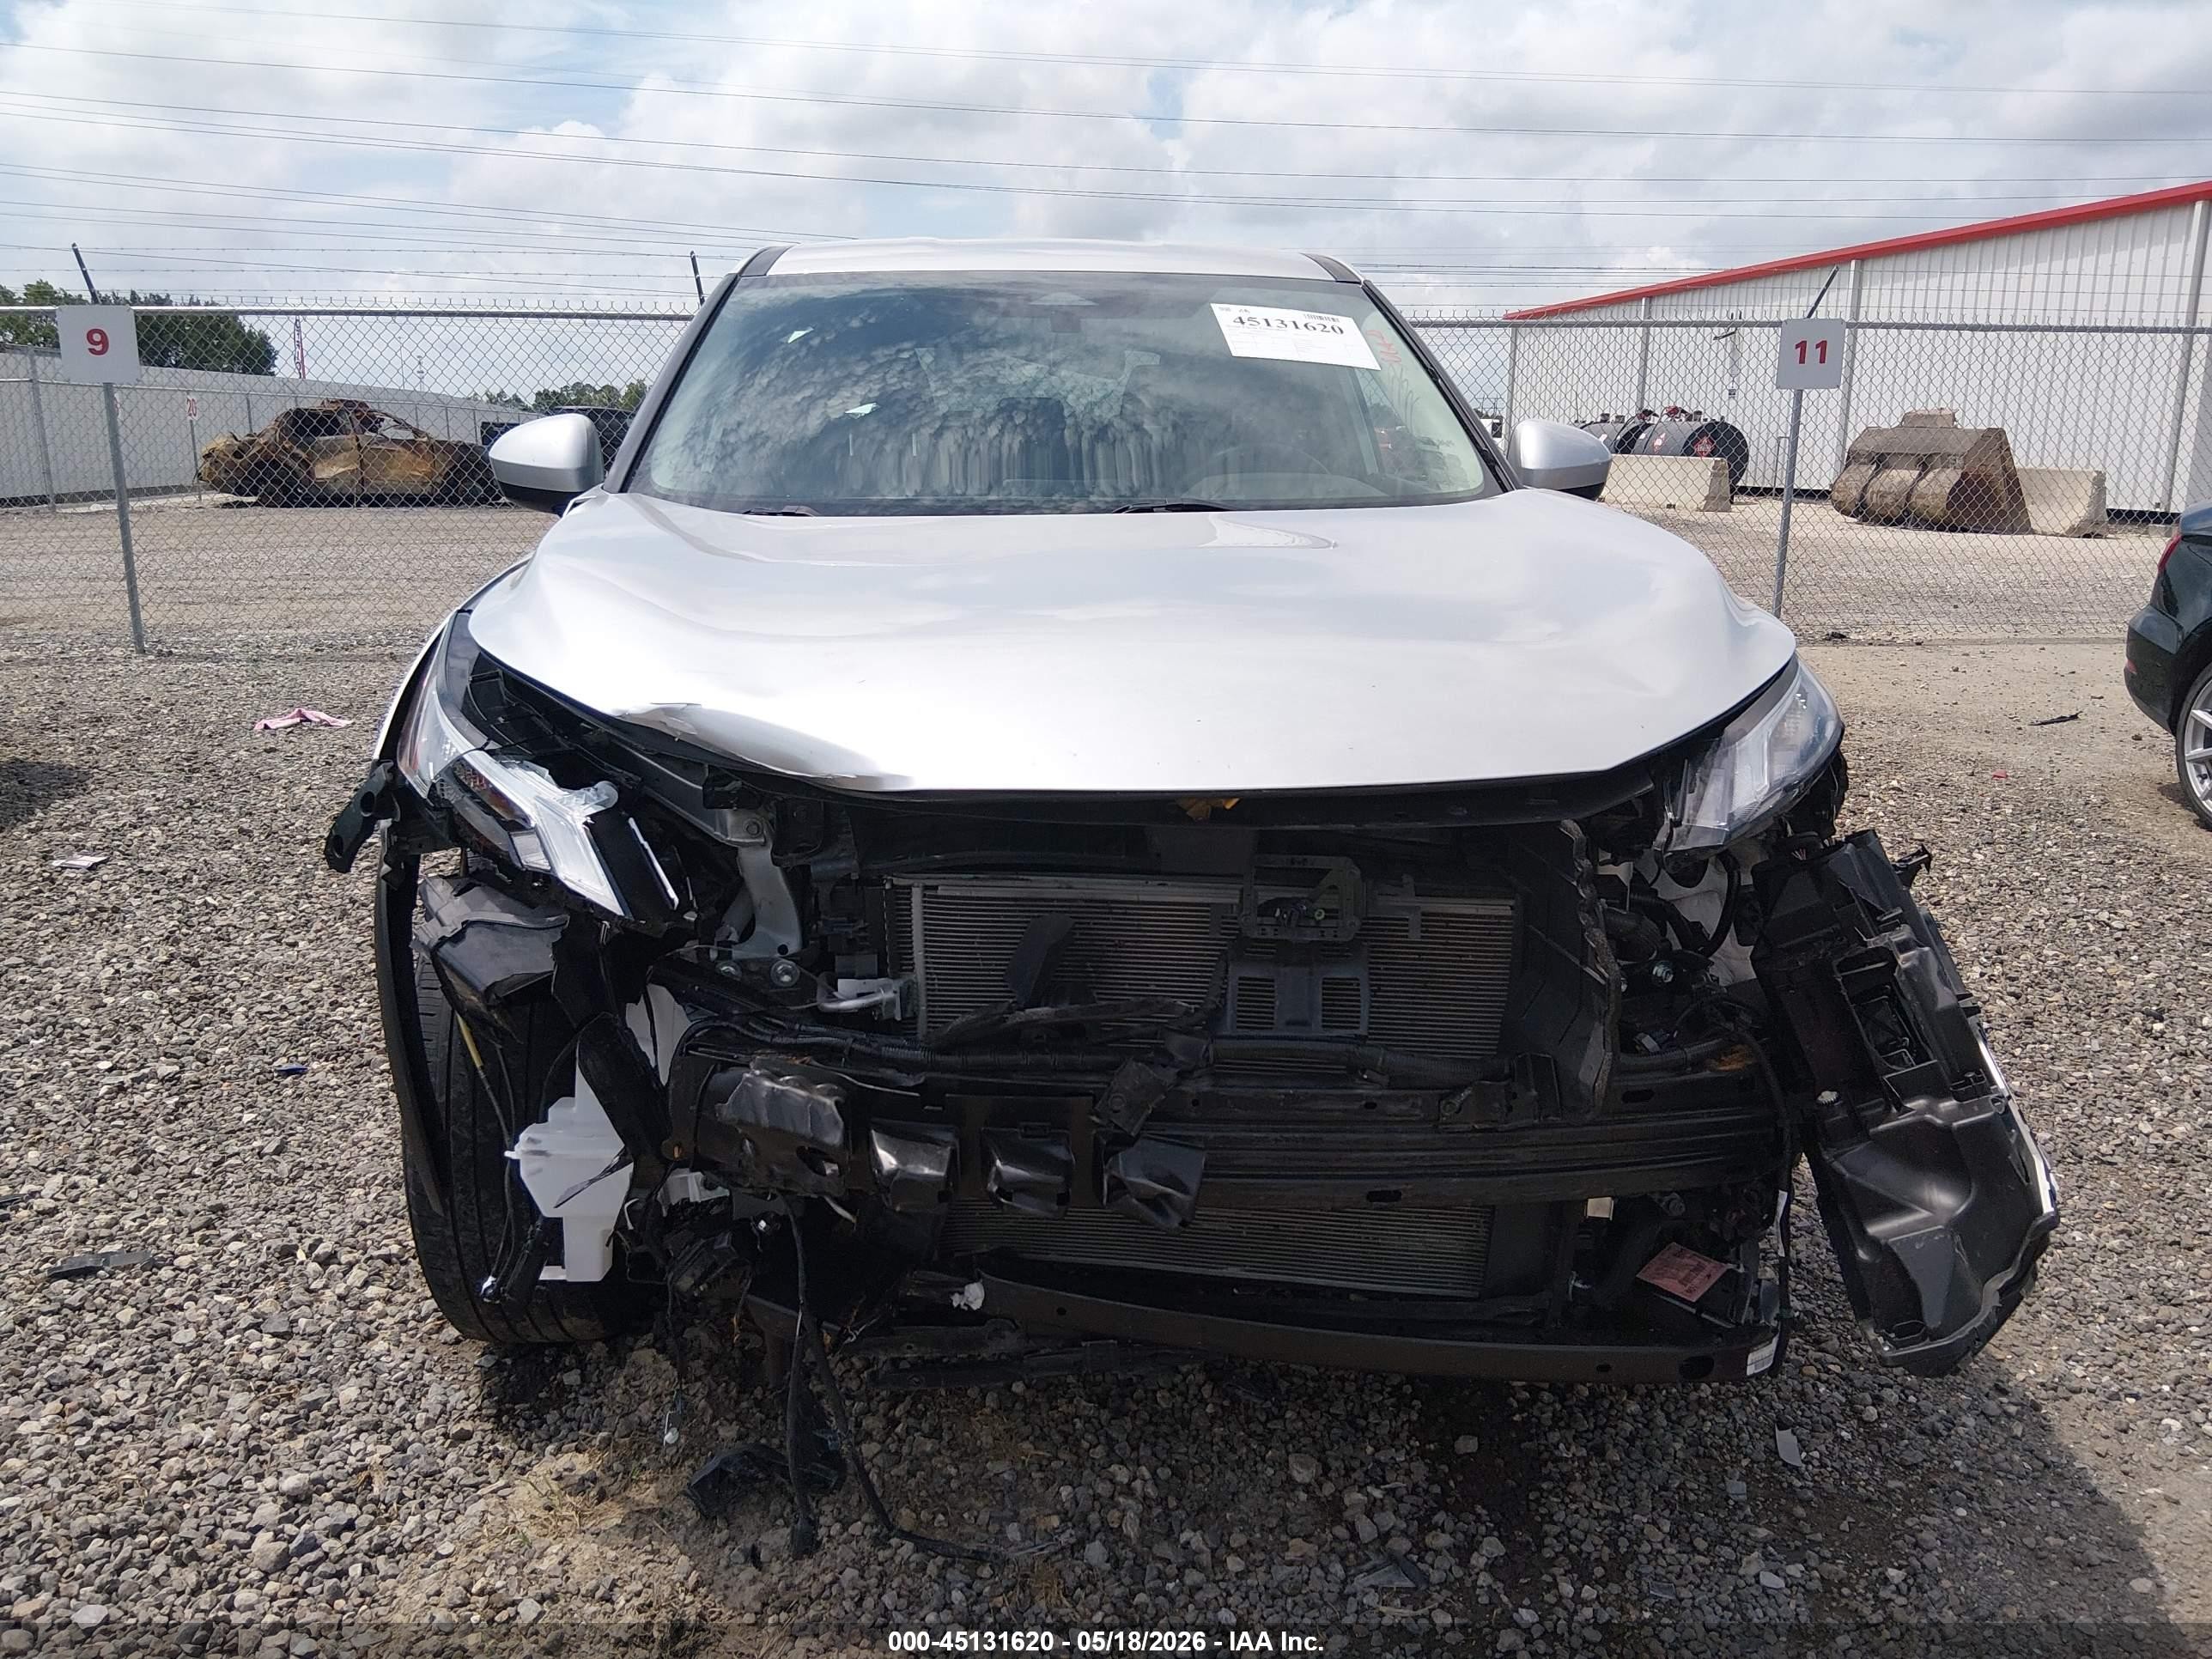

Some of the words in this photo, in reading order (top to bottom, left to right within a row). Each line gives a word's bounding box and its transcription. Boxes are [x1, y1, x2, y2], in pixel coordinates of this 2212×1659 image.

[1232, 315, 1345, 336] 45131620
[86, 328, 110, 356] 9
[1795, 340, 1828, 365] 11
